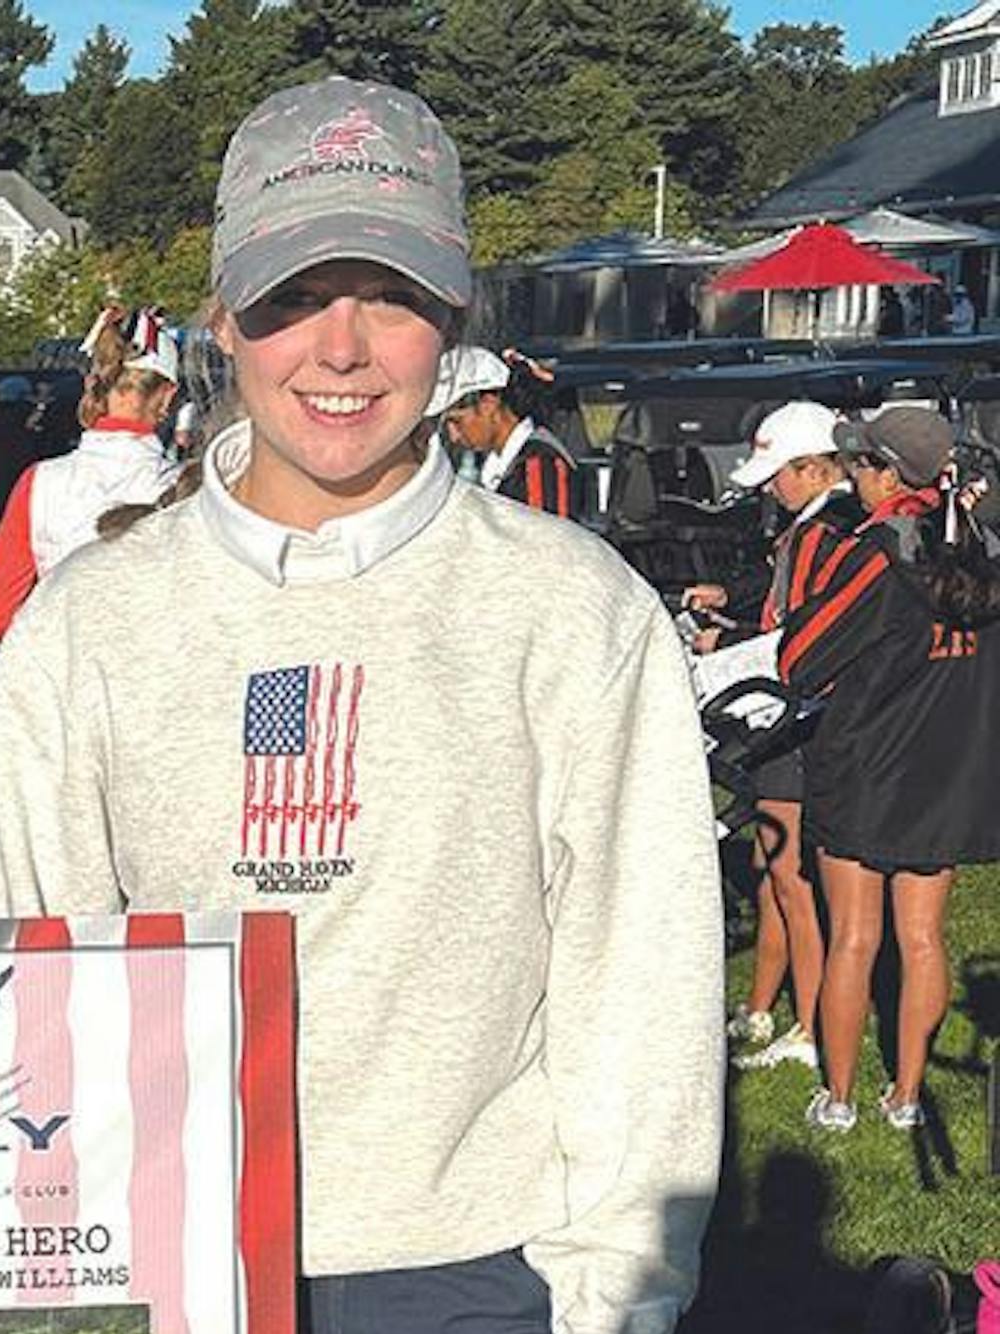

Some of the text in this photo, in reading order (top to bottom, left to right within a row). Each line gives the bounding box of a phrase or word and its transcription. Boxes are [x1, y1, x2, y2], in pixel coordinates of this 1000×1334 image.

[232, 859, 354, 877] GRAND HAVEN
[22, 1185, 71, 1196] CLUB
[5, 1223, 112, 1256] HERO
